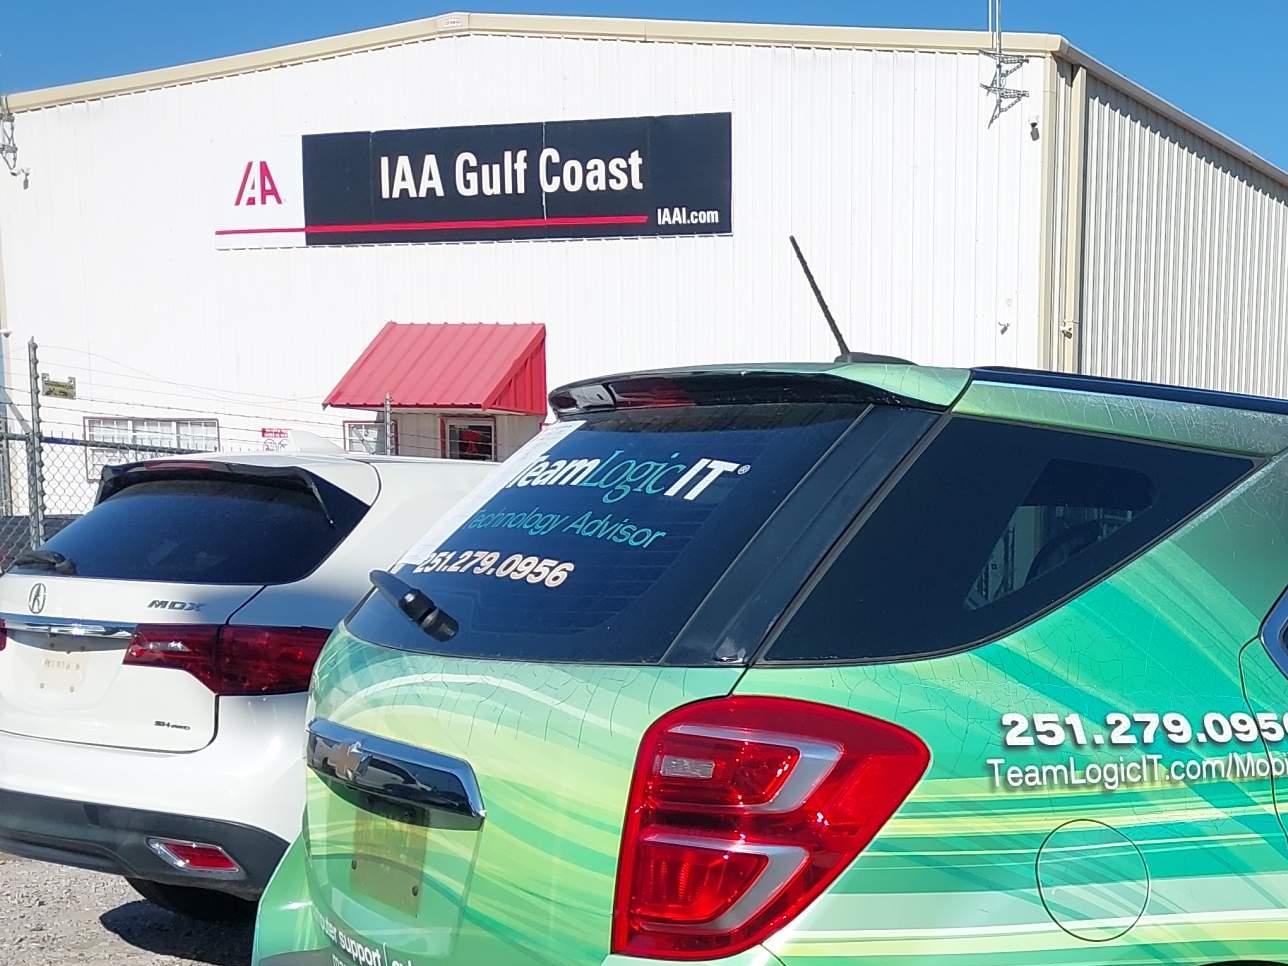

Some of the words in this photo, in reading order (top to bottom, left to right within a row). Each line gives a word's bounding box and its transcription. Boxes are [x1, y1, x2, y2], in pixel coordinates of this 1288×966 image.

[379, 153, 443, 199] IAA
[454, 148, 528, 196] Gulf
[539, 147, 644, 193] Coast
[656, 207, 719, 225] IAAI.com
[568, 515, 666, 549] Advisor
[412, 550, 574, 588] 251.279.0956
[148, 600, 205, 611] MDX
